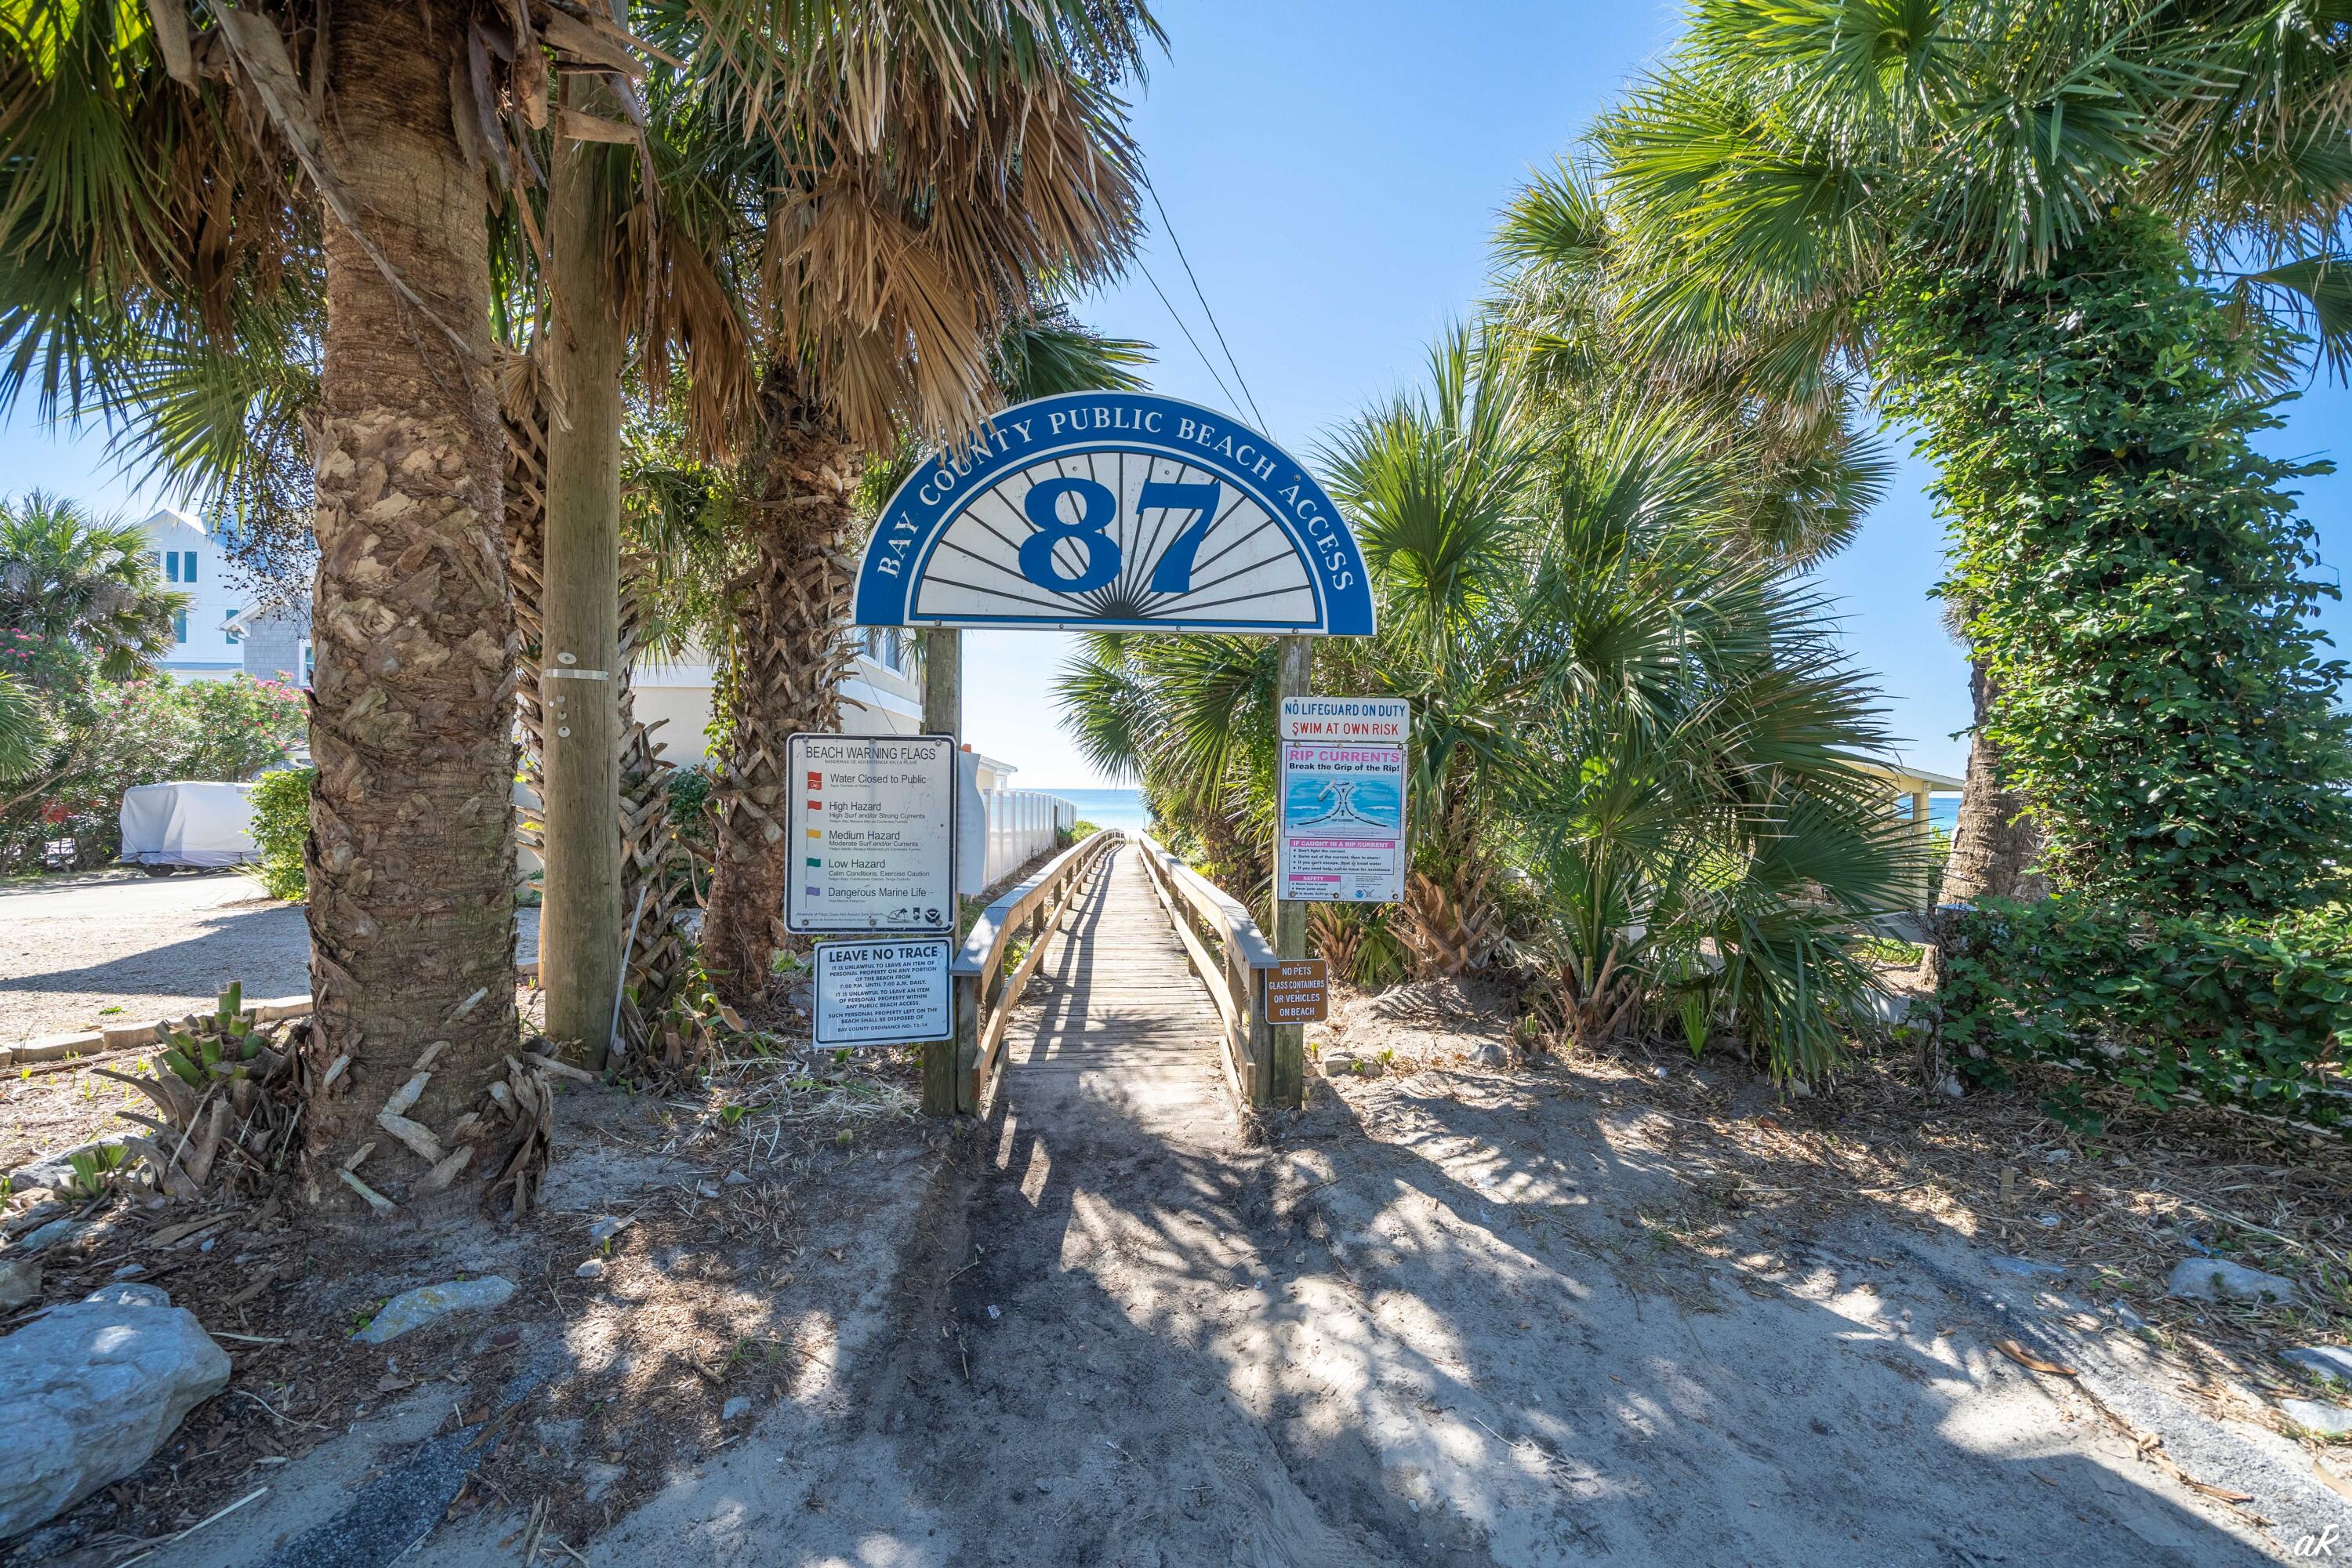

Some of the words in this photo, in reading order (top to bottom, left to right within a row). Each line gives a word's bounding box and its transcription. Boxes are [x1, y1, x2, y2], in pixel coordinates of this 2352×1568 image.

[877, 510, 919, 578] BAY
[920, 419, 1032, 505] COUNTY
[1047, 407, 1163, 434] PUBLIC
[1176, 416, 1277, 482] BEACH
[1278, 485, 1354, 590] ACCESS
[1018, 477, 1221, 593] 87
[1285, 703, 1298, 715] NO
[1302, 704, 1359, 716] LIFEGUARD
[1363, 705, 1376, 716] ON
[1379, 706, 1405, 717] DUTY
[1292, 722, 1321, 734] SWIM
[1326, 723, 1339, 734] AT
[1344, 724, 1368, 735] OWN
[1373, 724, 1398, 735] RISK
[806, 746, 843, 758] BEACH
[847, 747, 897, 759] WARNING
[901, 748, 935, 760] FLAGS
[1290, 750, 1314, 760] RIP
[1319, 751, 1399, 762] CURRENTS
[830, 774, 855, 783] Water
[858, 774, 887, 783] Closed
[902, 775, 926, 784] Public
[829, 801, 848, 812] High
[851, 802, 881, 811] Hazard
[829, 830, 864, 840] Medium
[868, 831, 900, 840] Hazard
[829, 859, 848, 868] Low
[851, 859, 885, 868] Hazard
[829, 887, 876, 898] Dangerous
[879, 887, 908, 897] Marine
[911, 888, 926, 897] Life
[829, 949, 868, 962] LEAVE
[873, 949, 893, 960] NO
[898, 946, 938, 959] TRACE
[1289, 980, 1324, 989] CONTAINERS
[1291, 1007, 1315, 1016] BEACH
